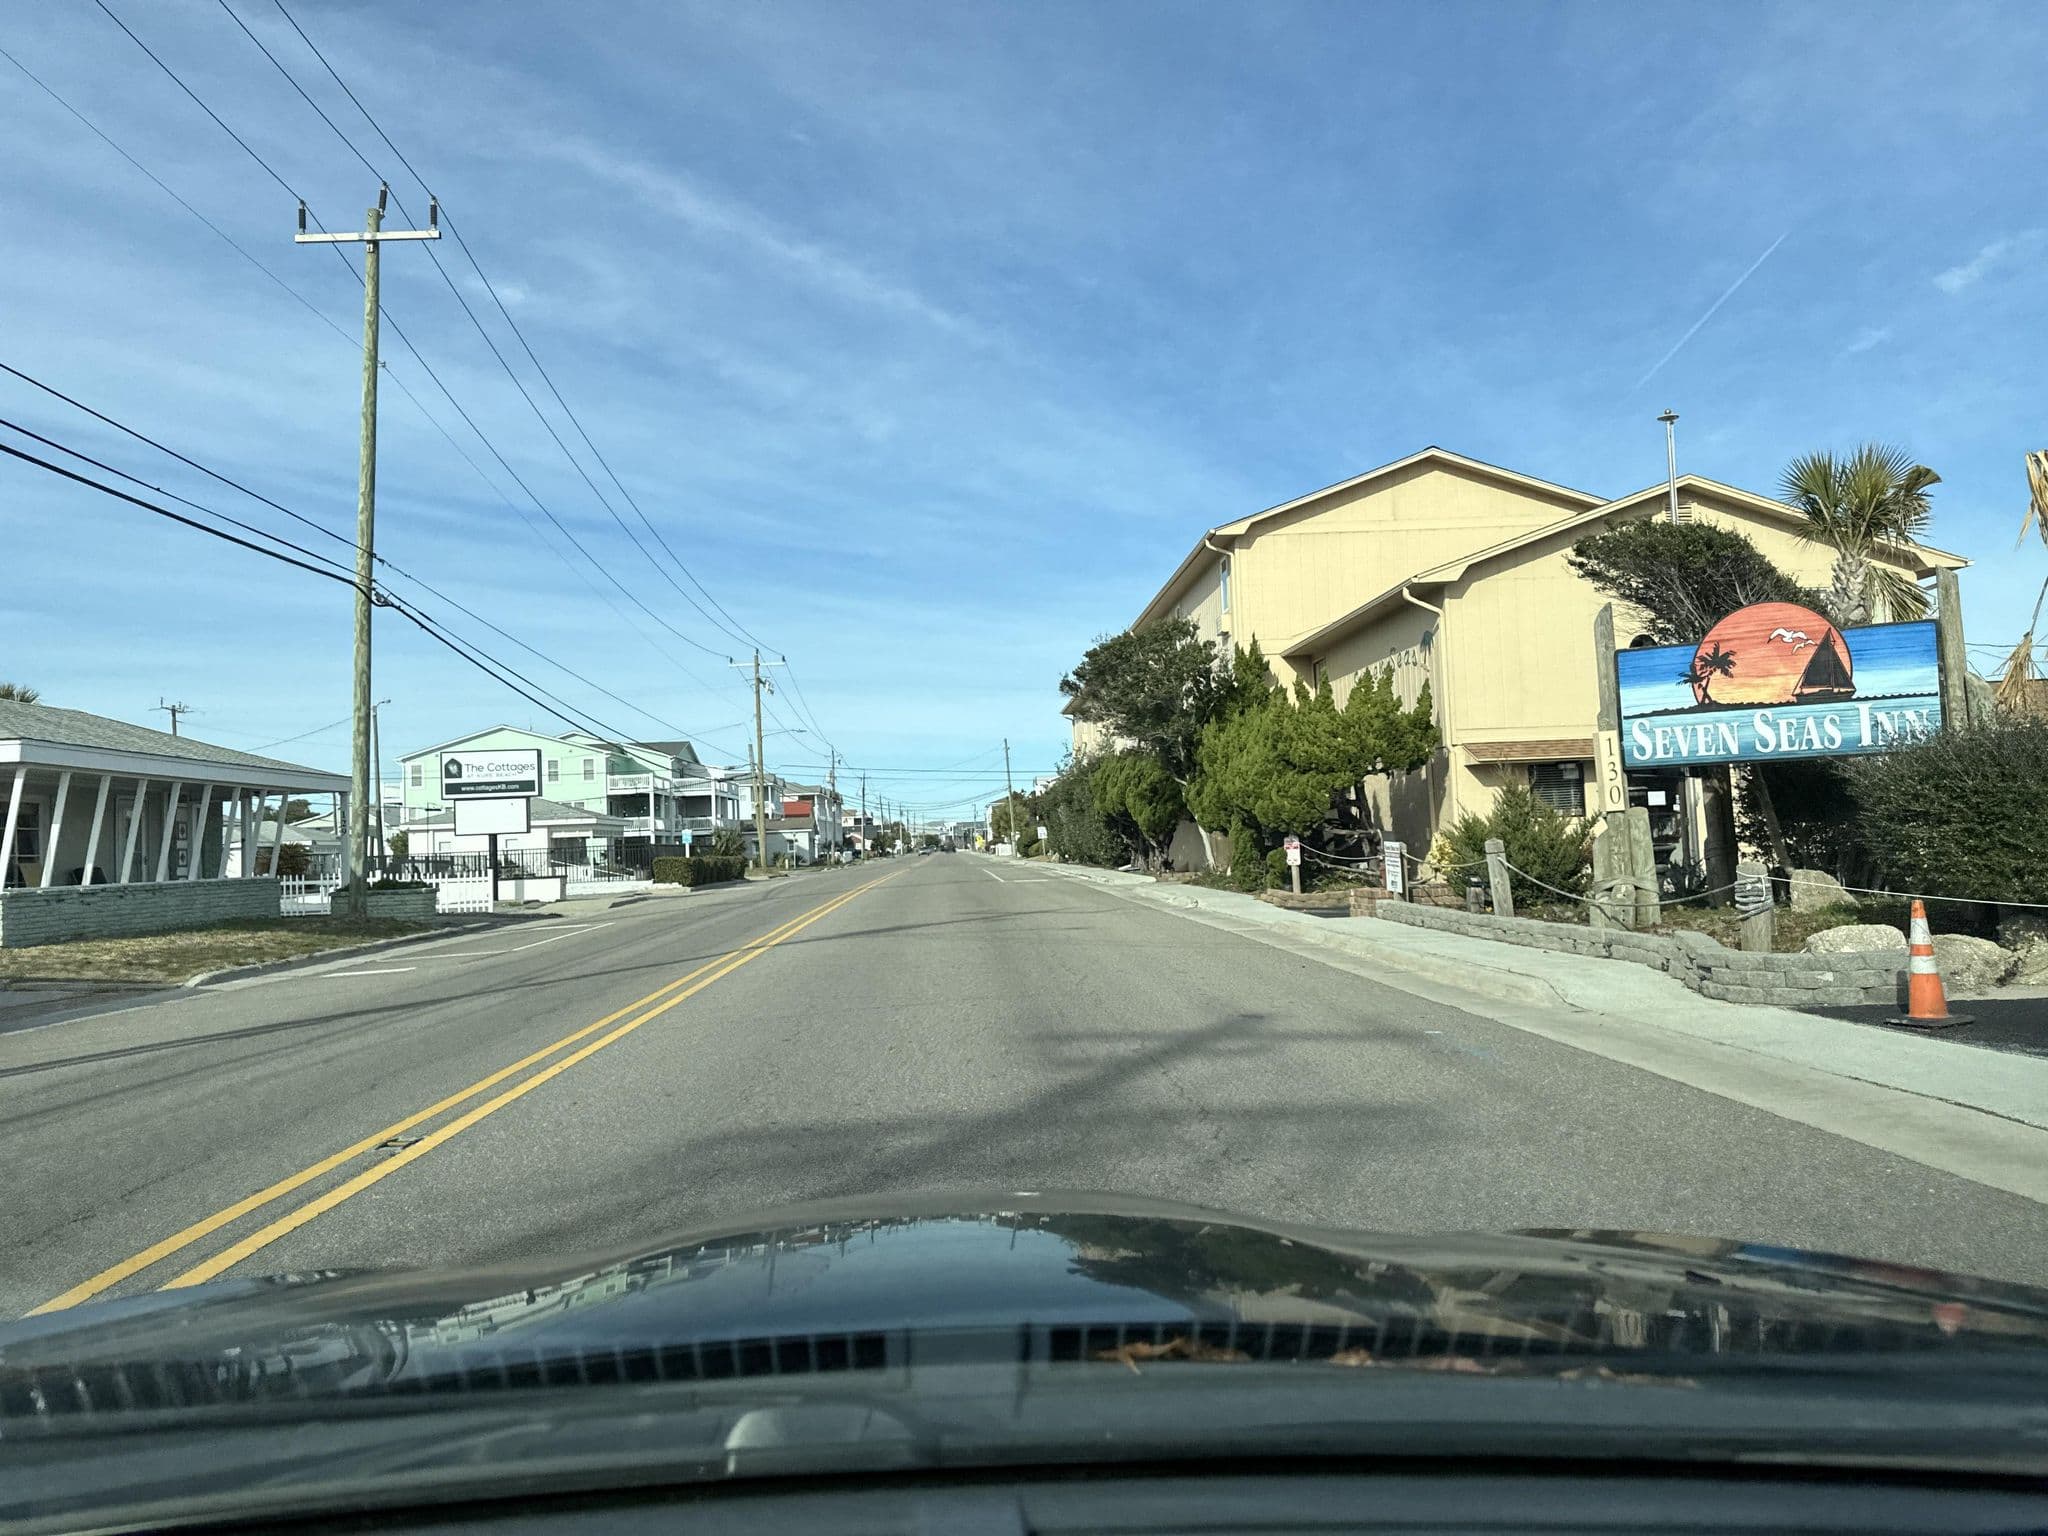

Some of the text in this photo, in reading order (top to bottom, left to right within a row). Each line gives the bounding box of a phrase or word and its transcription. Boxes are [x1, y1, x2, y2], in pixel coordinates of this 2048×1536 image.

[1632, 702, 1930, 761] SEVEN SEAS INN
[464, 762, 536, 774] The Cottages
[1605, 737, 1621, 804] 130
